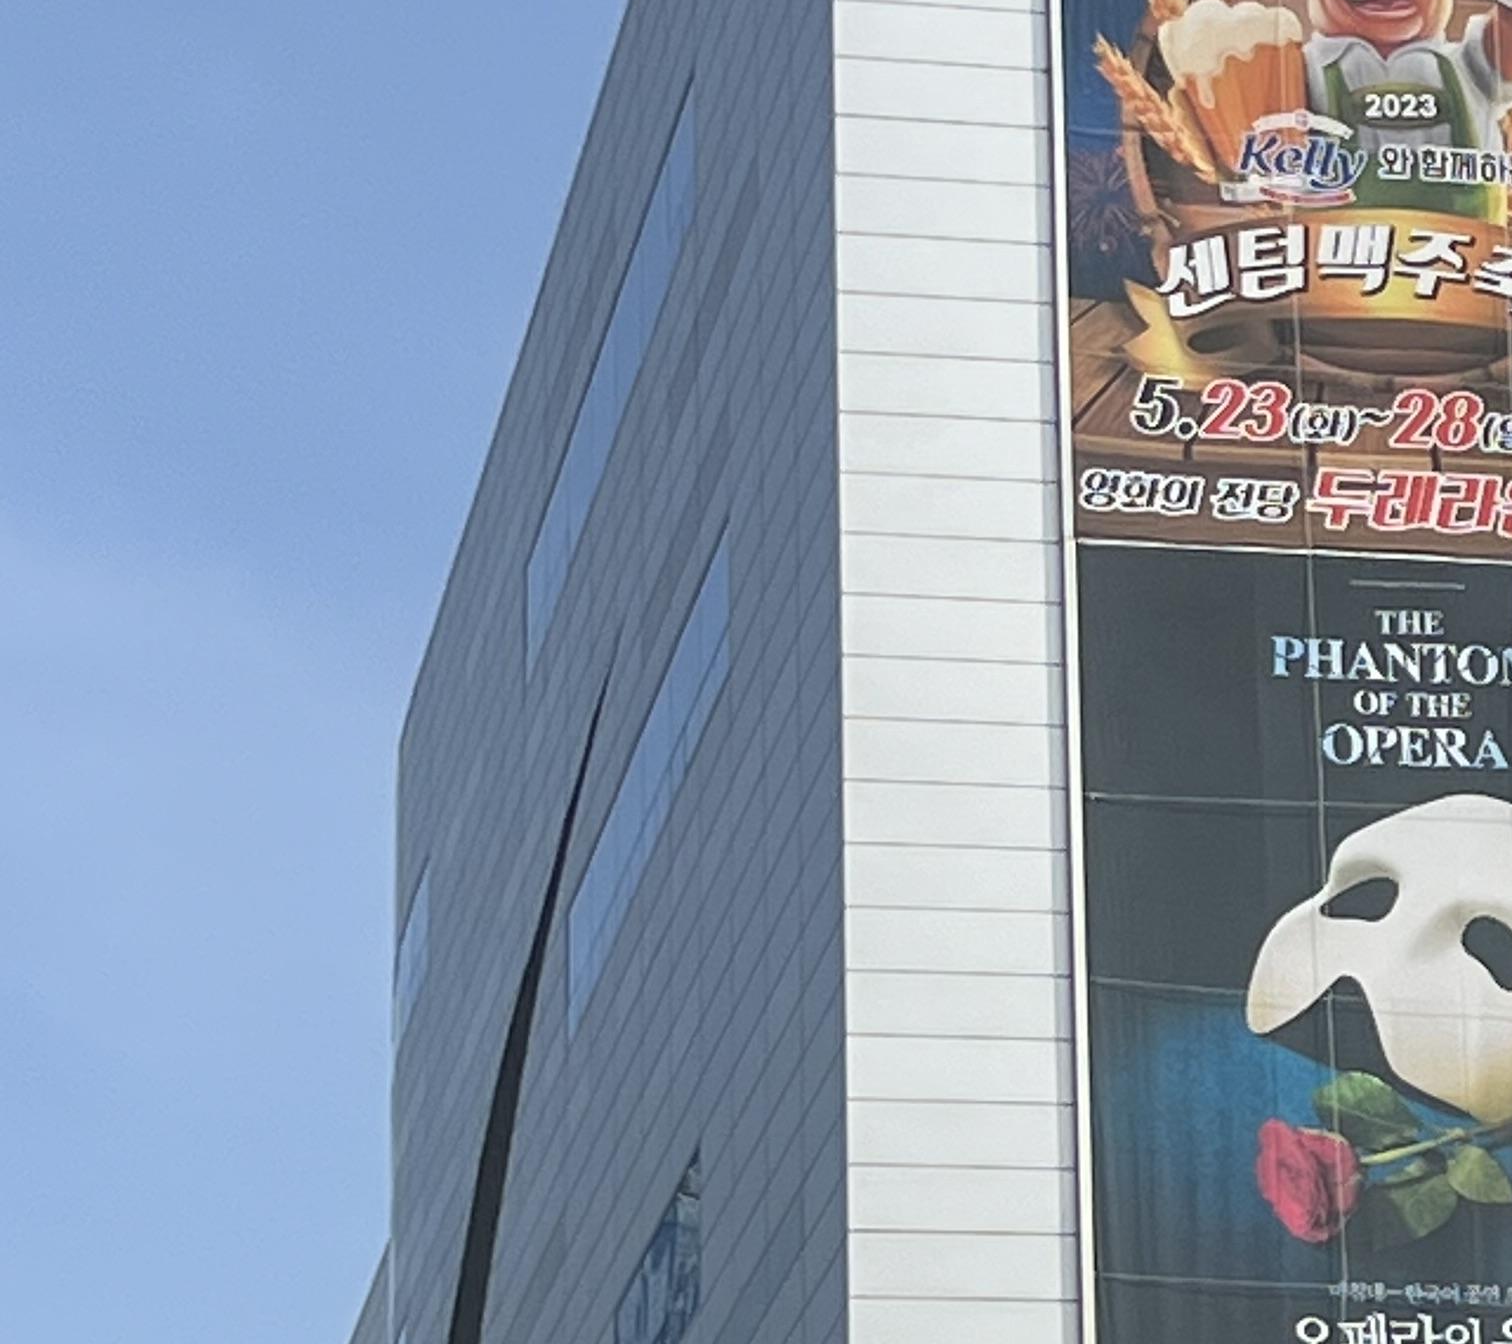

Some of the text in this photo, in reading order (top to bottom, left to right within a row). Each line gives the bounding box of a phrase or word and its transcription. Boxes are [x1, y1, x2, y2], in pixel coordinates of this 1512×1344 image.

[1365, 94, 1437, 119] 2023
[1239, 131, 1368, 191] Kelly
[1379, 145, 1412, 179] 와
[1081, 470, 1205, 515] 영화의
[1212, 478, 1299, 522] 전당
[1375, 610, 1444, 635] THE
[1353, 690, 1472, 718] OF THE
[1321, 723, 1509, 769] OPERA
